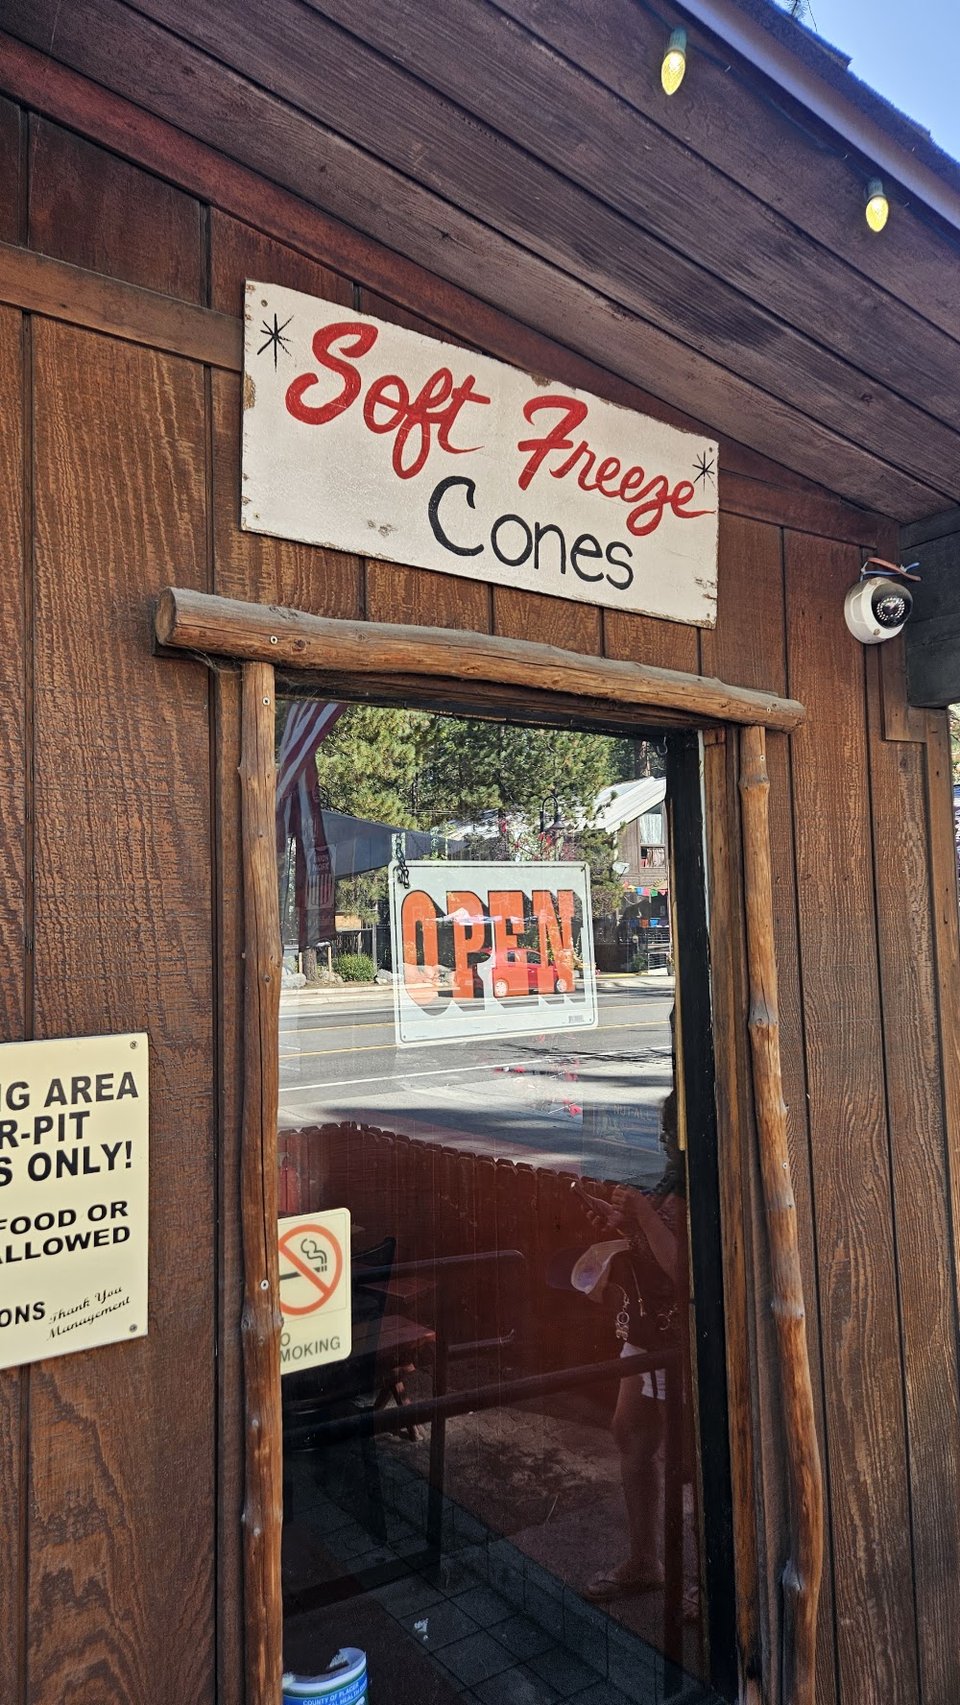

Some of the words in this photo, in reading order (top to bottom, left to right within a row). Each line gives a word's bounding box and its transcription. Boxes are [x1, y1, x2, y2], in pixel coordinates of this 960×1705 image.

[285, 322, 490, 480] Soft
[518, 394, 716, 537] Freeze
[428, 475, 635, 591] Cones
[401, 889, 582, 1008] OPEN
[0, 1082, 30, 1111] G
[44, 1072, 139, 1107] AREA
[0, 1111, 90, 1150] R-PIT
[28, 1141, 132, 1182] ONLY!
[87, 1201, 128, 1222] OR
[0, 1226, 131, 1265] LLOWED
[0, 1302, 46, 1328] ONS
[47, 1296, 131, 1341] Management
[48, 1297, 90, 1325] Thank
[95, 1286, 123, 1305] You
[280, 1332, 291, 1347] O
[280, 1335, 341, 1363] MOKING
[330, 1693, 337, 1702] OF
